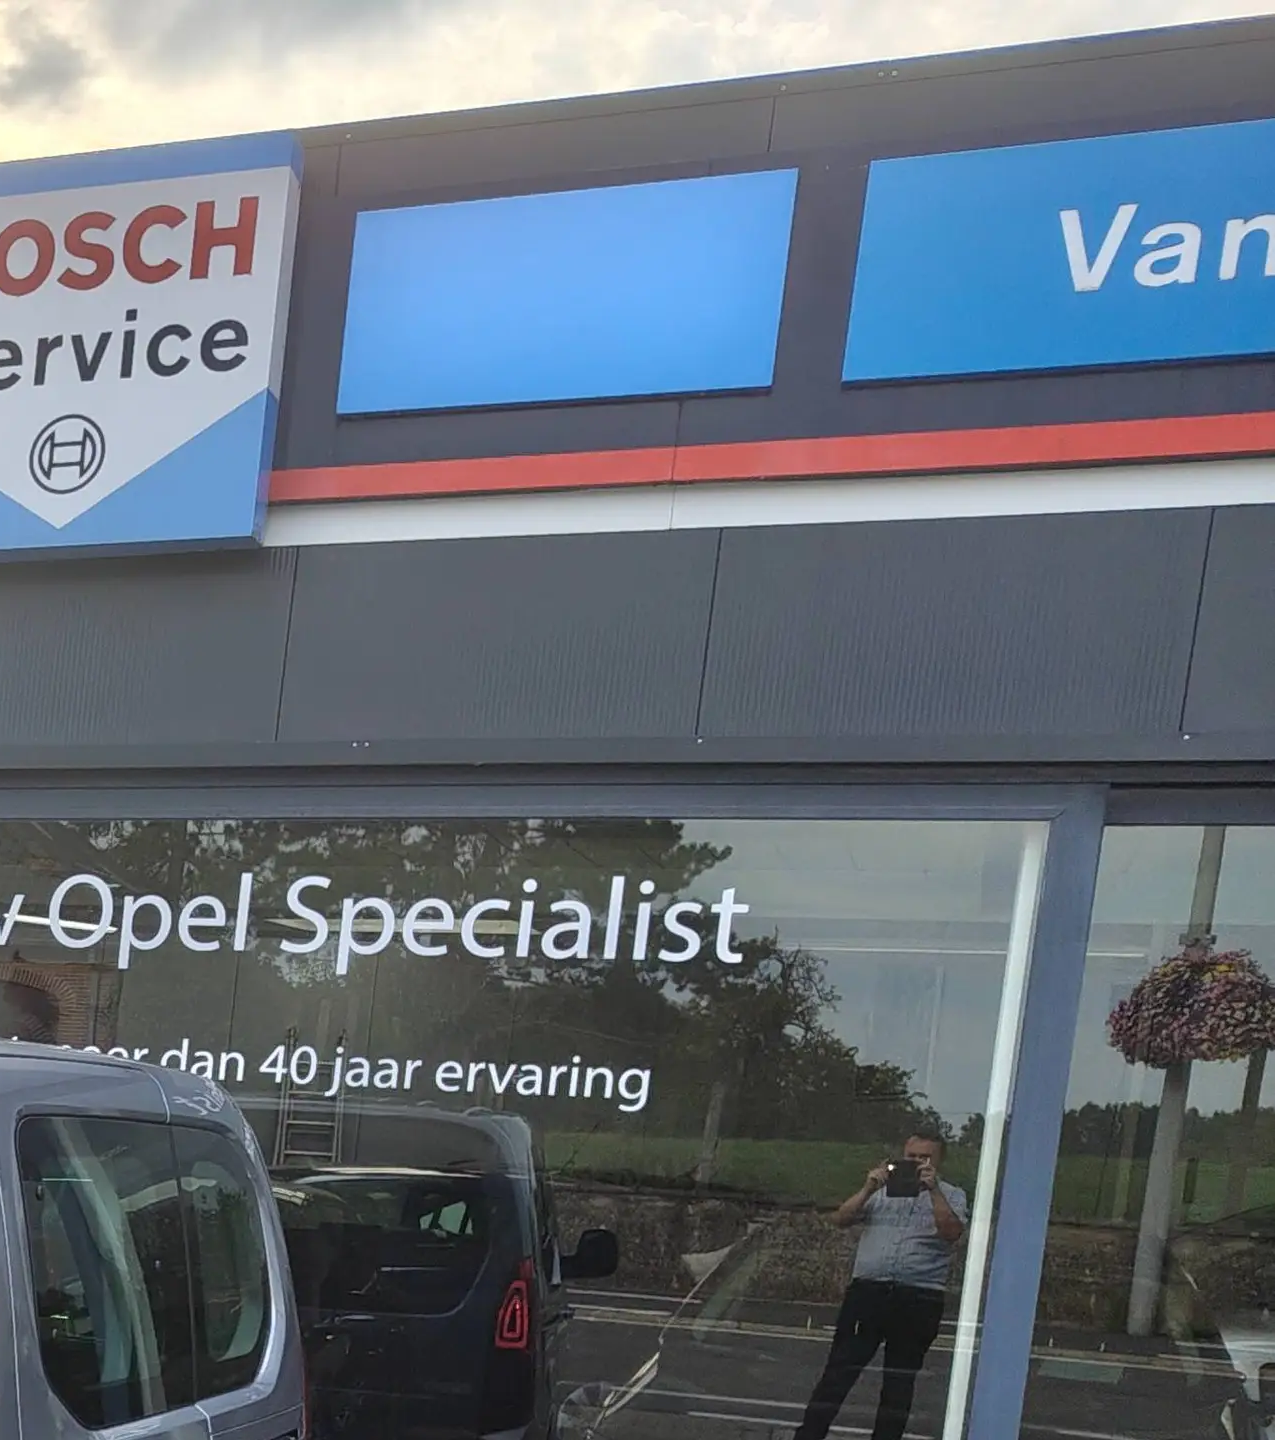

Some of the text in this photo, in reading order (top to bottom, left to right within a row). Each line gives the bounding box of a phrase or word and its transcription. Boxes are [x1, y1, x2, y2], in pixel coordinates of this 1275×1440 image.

[1058, 203, 1275, 292] Van
[48, 872, 254, 971] Opel
[279, 874, 751, 974] Specialist
[160, 1038, 653, 1113] dan 40 jaar ervaring
